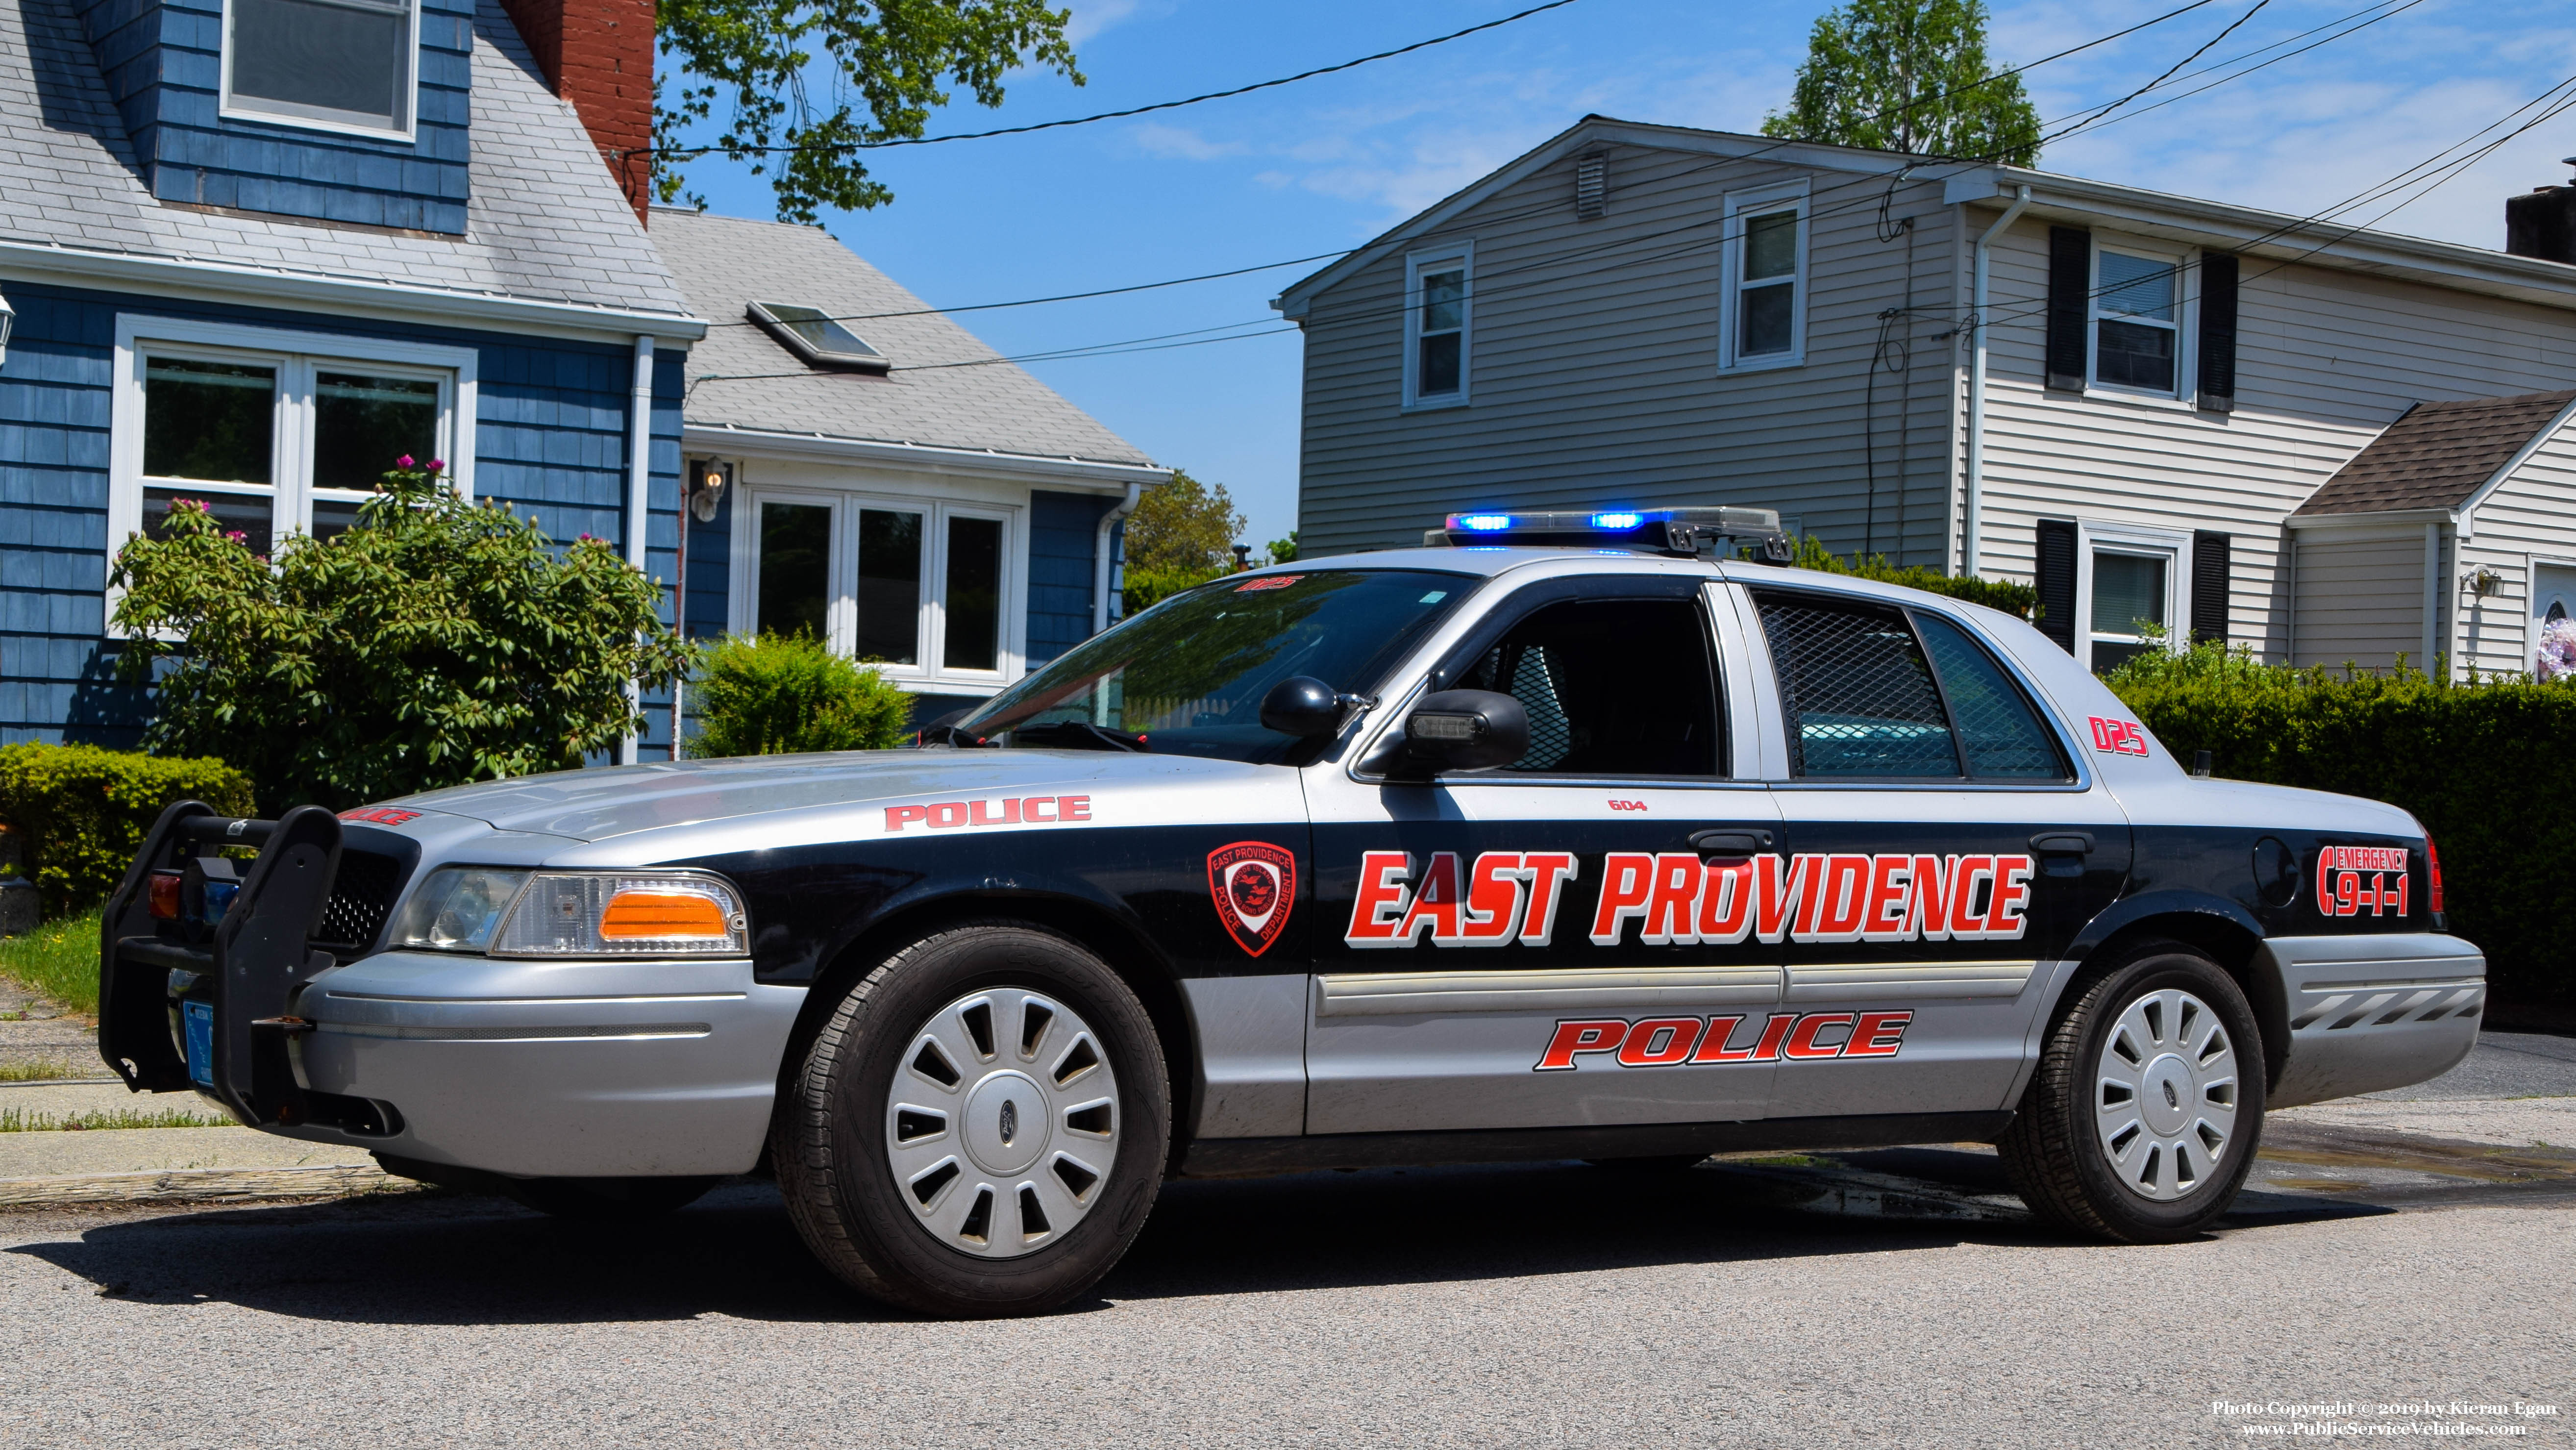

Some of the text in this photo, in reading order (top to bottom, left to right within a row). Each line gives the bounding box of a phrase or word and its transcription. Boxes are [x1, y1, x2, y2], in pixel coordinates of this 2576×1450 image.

[1234, 575, 1305, 592] D25
[2087, 715, 2149, 757] D25
[884, 795, 1092, 832] POLICE
[1608, 800, 1647, 811] 604
[1213, 847, 1290, 871] EAST PROVIDENCE
[1233, 866, 1273, 886] RHODE ISLAND
[2335, 846, 2408, 872] EMERGENCY
[1215, 886, 1242, 930] POLICE
[1261, 871, 1291, 941] DEPARTMENT
[1345, 850, 2035, 949] EAST PROVIDENCE
[2336, 871, 2408, 917] 9-1-1
[1532, 1008, 1915, 1072] POLICE
